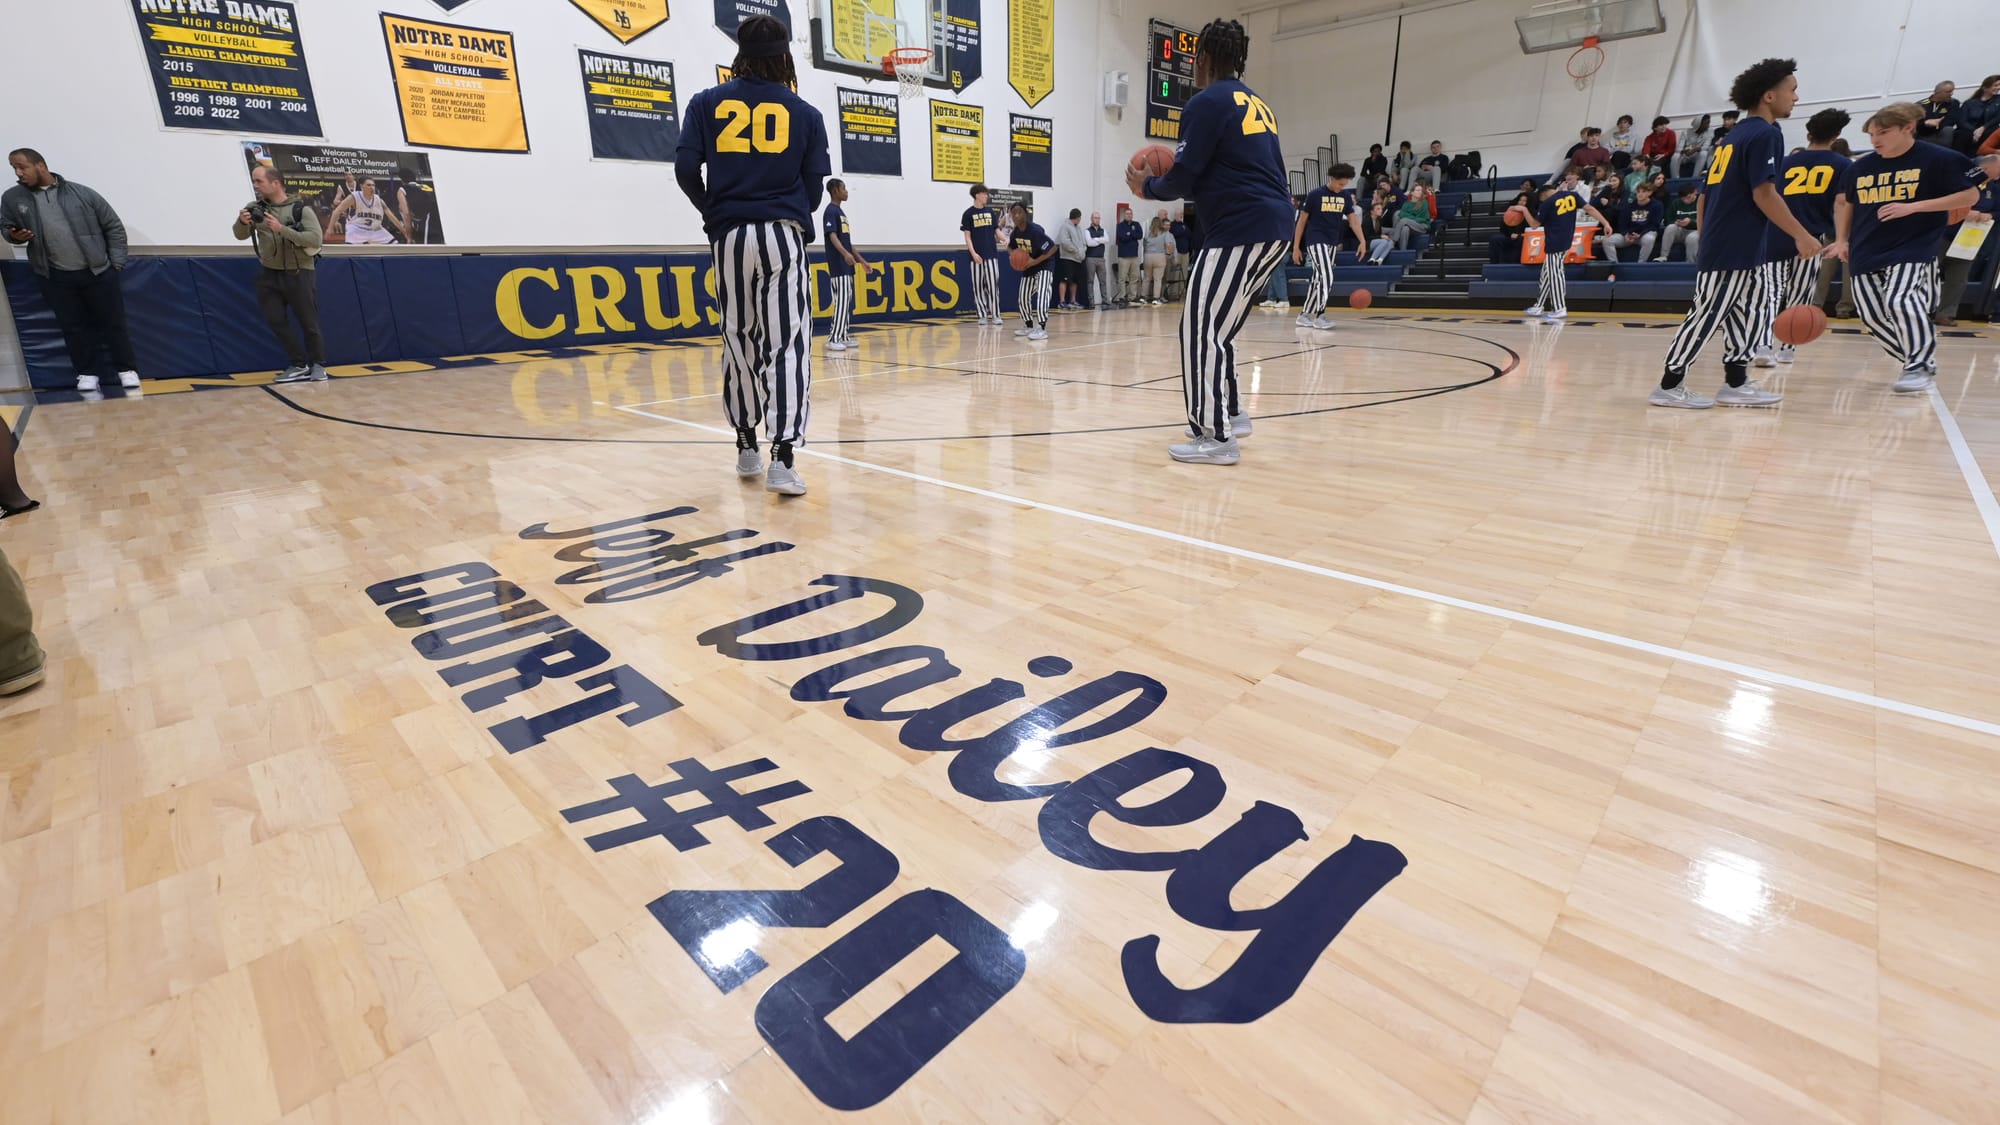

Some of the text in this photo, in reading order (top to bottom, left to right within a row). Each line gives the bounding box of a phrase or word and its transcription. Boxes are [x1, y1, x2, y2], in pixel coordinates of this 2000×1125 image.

[140, 0, 293, 32] NOTRE DAME
[736, 3, 771, 16] VOLLEYBALL
[181, 16, 262, 35] HIGH SCHOOL
[194, 33, 258, 48] VOLLEYBALL
[392, 24, 508, 59] NOTRE DAME
[168, 45, 287, 67] LEAGUE CHAMPIONS
[425, 49, 484, 63] HIGH SCHOOL
[1164, 39, 1171, 59] 0
[163, 60, 193, 73] 2015
[433, 63, 481, 76] VOLLEYBALL
[583, 54, 672, 85] NOTRE DAME
[170, 76, 298, 97] DISTRICT CHAMPIONS
[434, 78, 483, 89] ALL STATE
[607, 75, 654, 87] HIGH SCHOOL
[1162, 81, 1168, 97] 0
[430, 89, 454, 97] JORDAN
[455, 92, 485, 101] APPLETON
[610, 86, 654, 98] CHEERLEADING
[169, 92, 307, 112] 1996 1998 2001 2004
[612, 98, 653, 110] CHAMPIONS
[840, 90, 897, 113] NOTRE DAME
[174, 105, 239, 119] 2006 2022
[453, 107, 485, 115] CAMPBELL
[454, 114, 486, 122] CAMPBELL
[933, 105, 981, 124] NOTRE DAME
[1233, 91, 1278, 135] 20
[715, 99, 790, 154] 20
[866, 126, 893, 134] CHAMPIONS
[321, 148, 357, 158] Welcome
[292, 155, 397, 168] The JEFF DAILEY Memorial
[305, 164, 389, 175] Basketball Tournament
[309, 180, 334, 188] Brothers
[1783, 165, 1835, 195] 20
[1856, 168, 1921, 189] DO IT FOR
[1856, 182, 1919, 204] DAILEY
[1554, 195, 1577, 216] 20
[1530, 237, 1541, 247] G
[495, 259, 960, 340] CRUSDERS
[518, 506, 1408, 1024] Jeff Dailey
[365, 561, 1027, 1112] COURT #20
